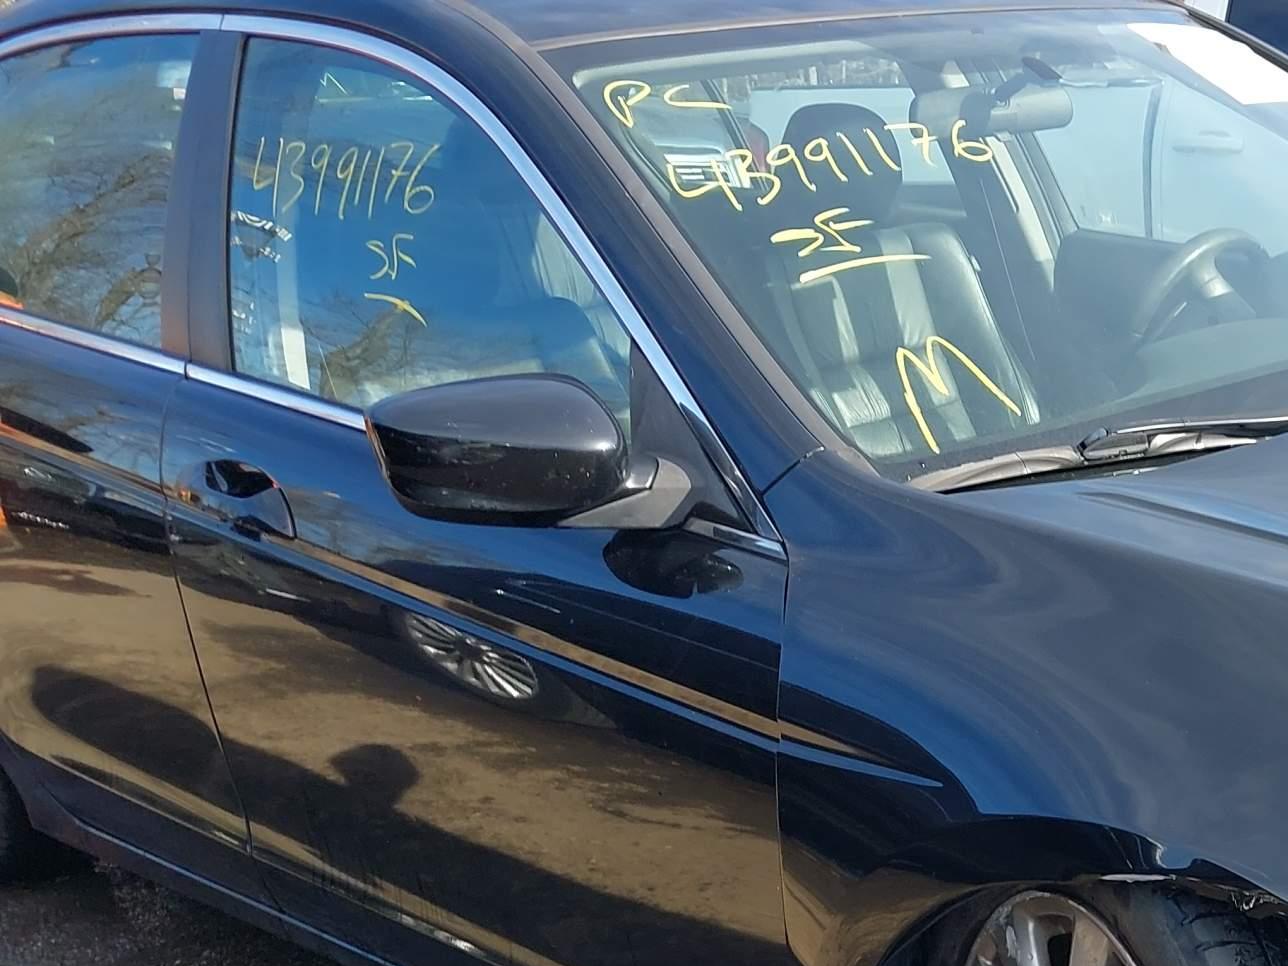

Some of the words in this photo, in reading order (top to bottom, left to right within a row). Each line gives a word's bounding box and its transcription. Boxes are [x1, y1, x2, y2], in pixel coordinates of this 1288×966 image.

[253, 135, 441, 221] 43991176
[667, 119, 994, 212] 43991176
[897, 335, 1022, 454] M
